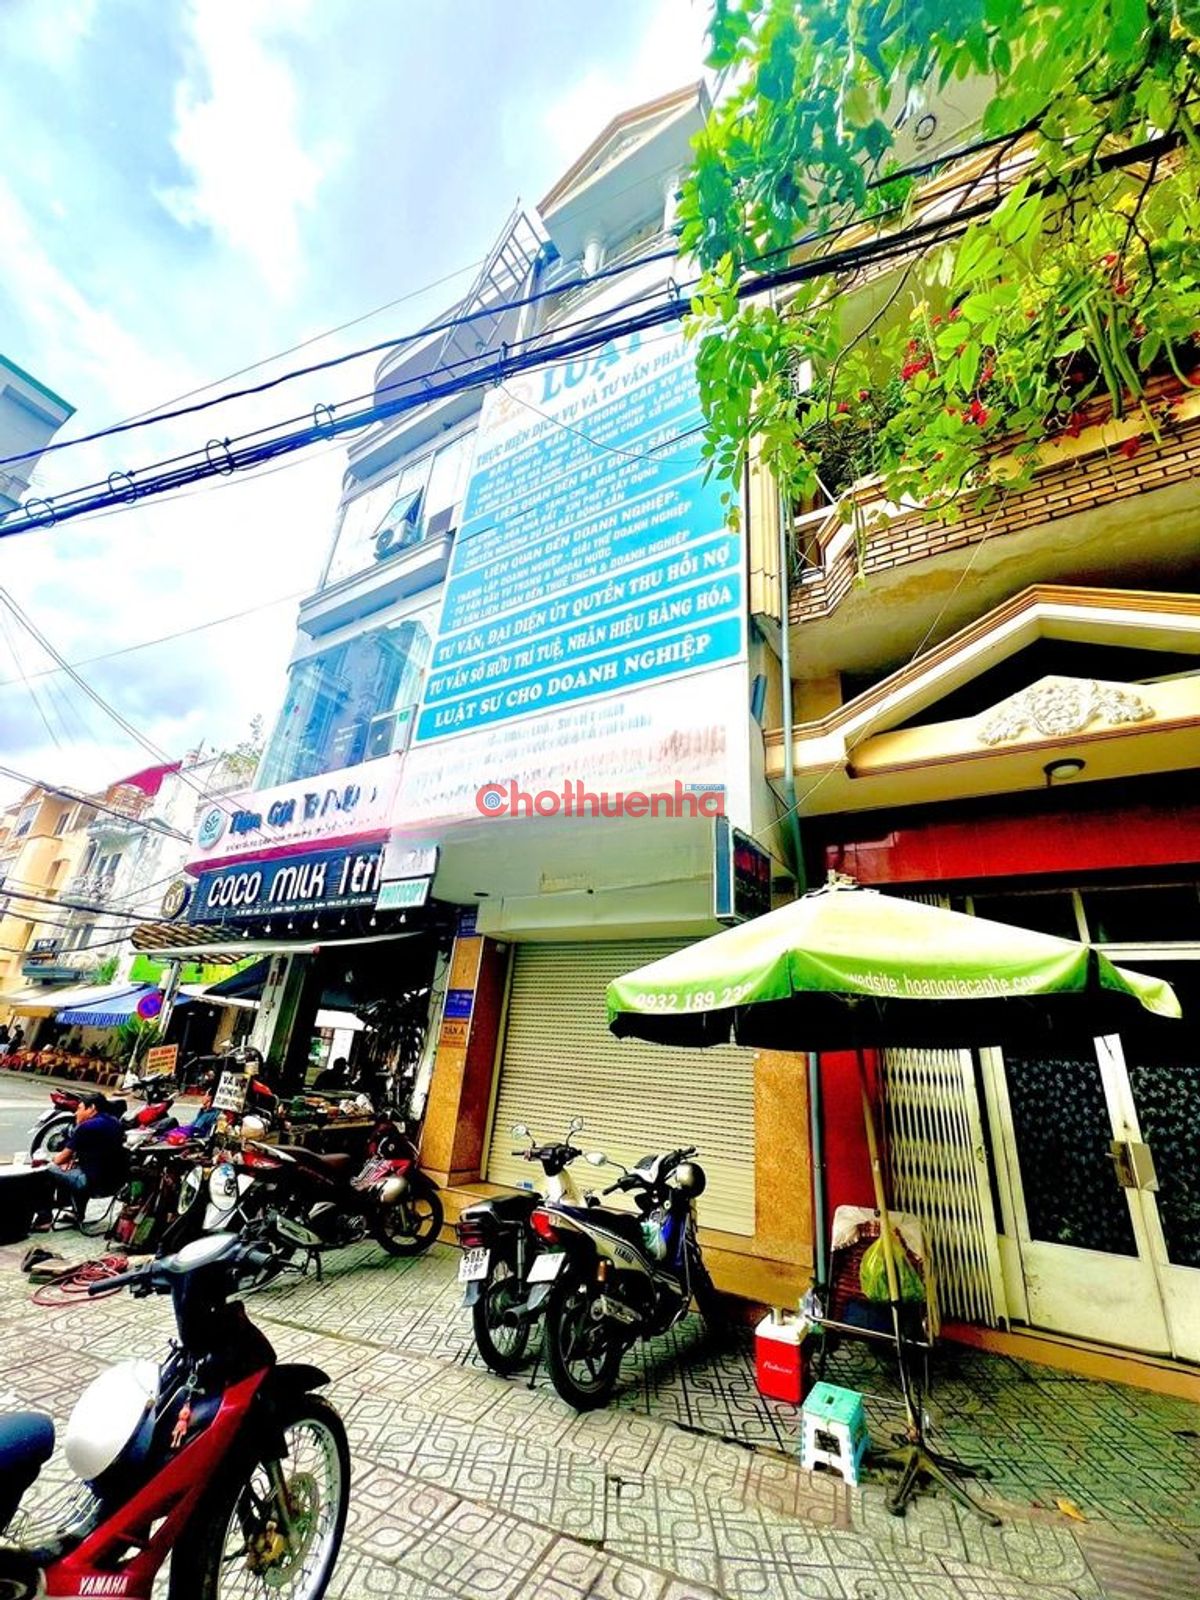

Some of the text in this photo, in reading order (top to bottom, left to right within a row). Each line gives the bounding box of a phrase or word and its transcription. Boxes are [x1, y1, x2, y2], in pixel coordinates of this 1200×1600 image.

[629, 570, 662, 593] THU
[609, 613, 644, 639] HIỆU
[647, 598, 692, 626] HÀNG
[696, 585, 731, 611] HÓA
[435, 701, 477, 727] LUẬT
[479, 692, 503, 715] SƯ
[506, 683, 543, 707] CHO
[547, 662, 617, 695] DOANH
[625, 633, 710, 673] NGHIỆP
[207, 872, 262, 907] COCO
[269, 861, 328, 902] MILK
[79, 1576, 129, 1595] YAMAHA
